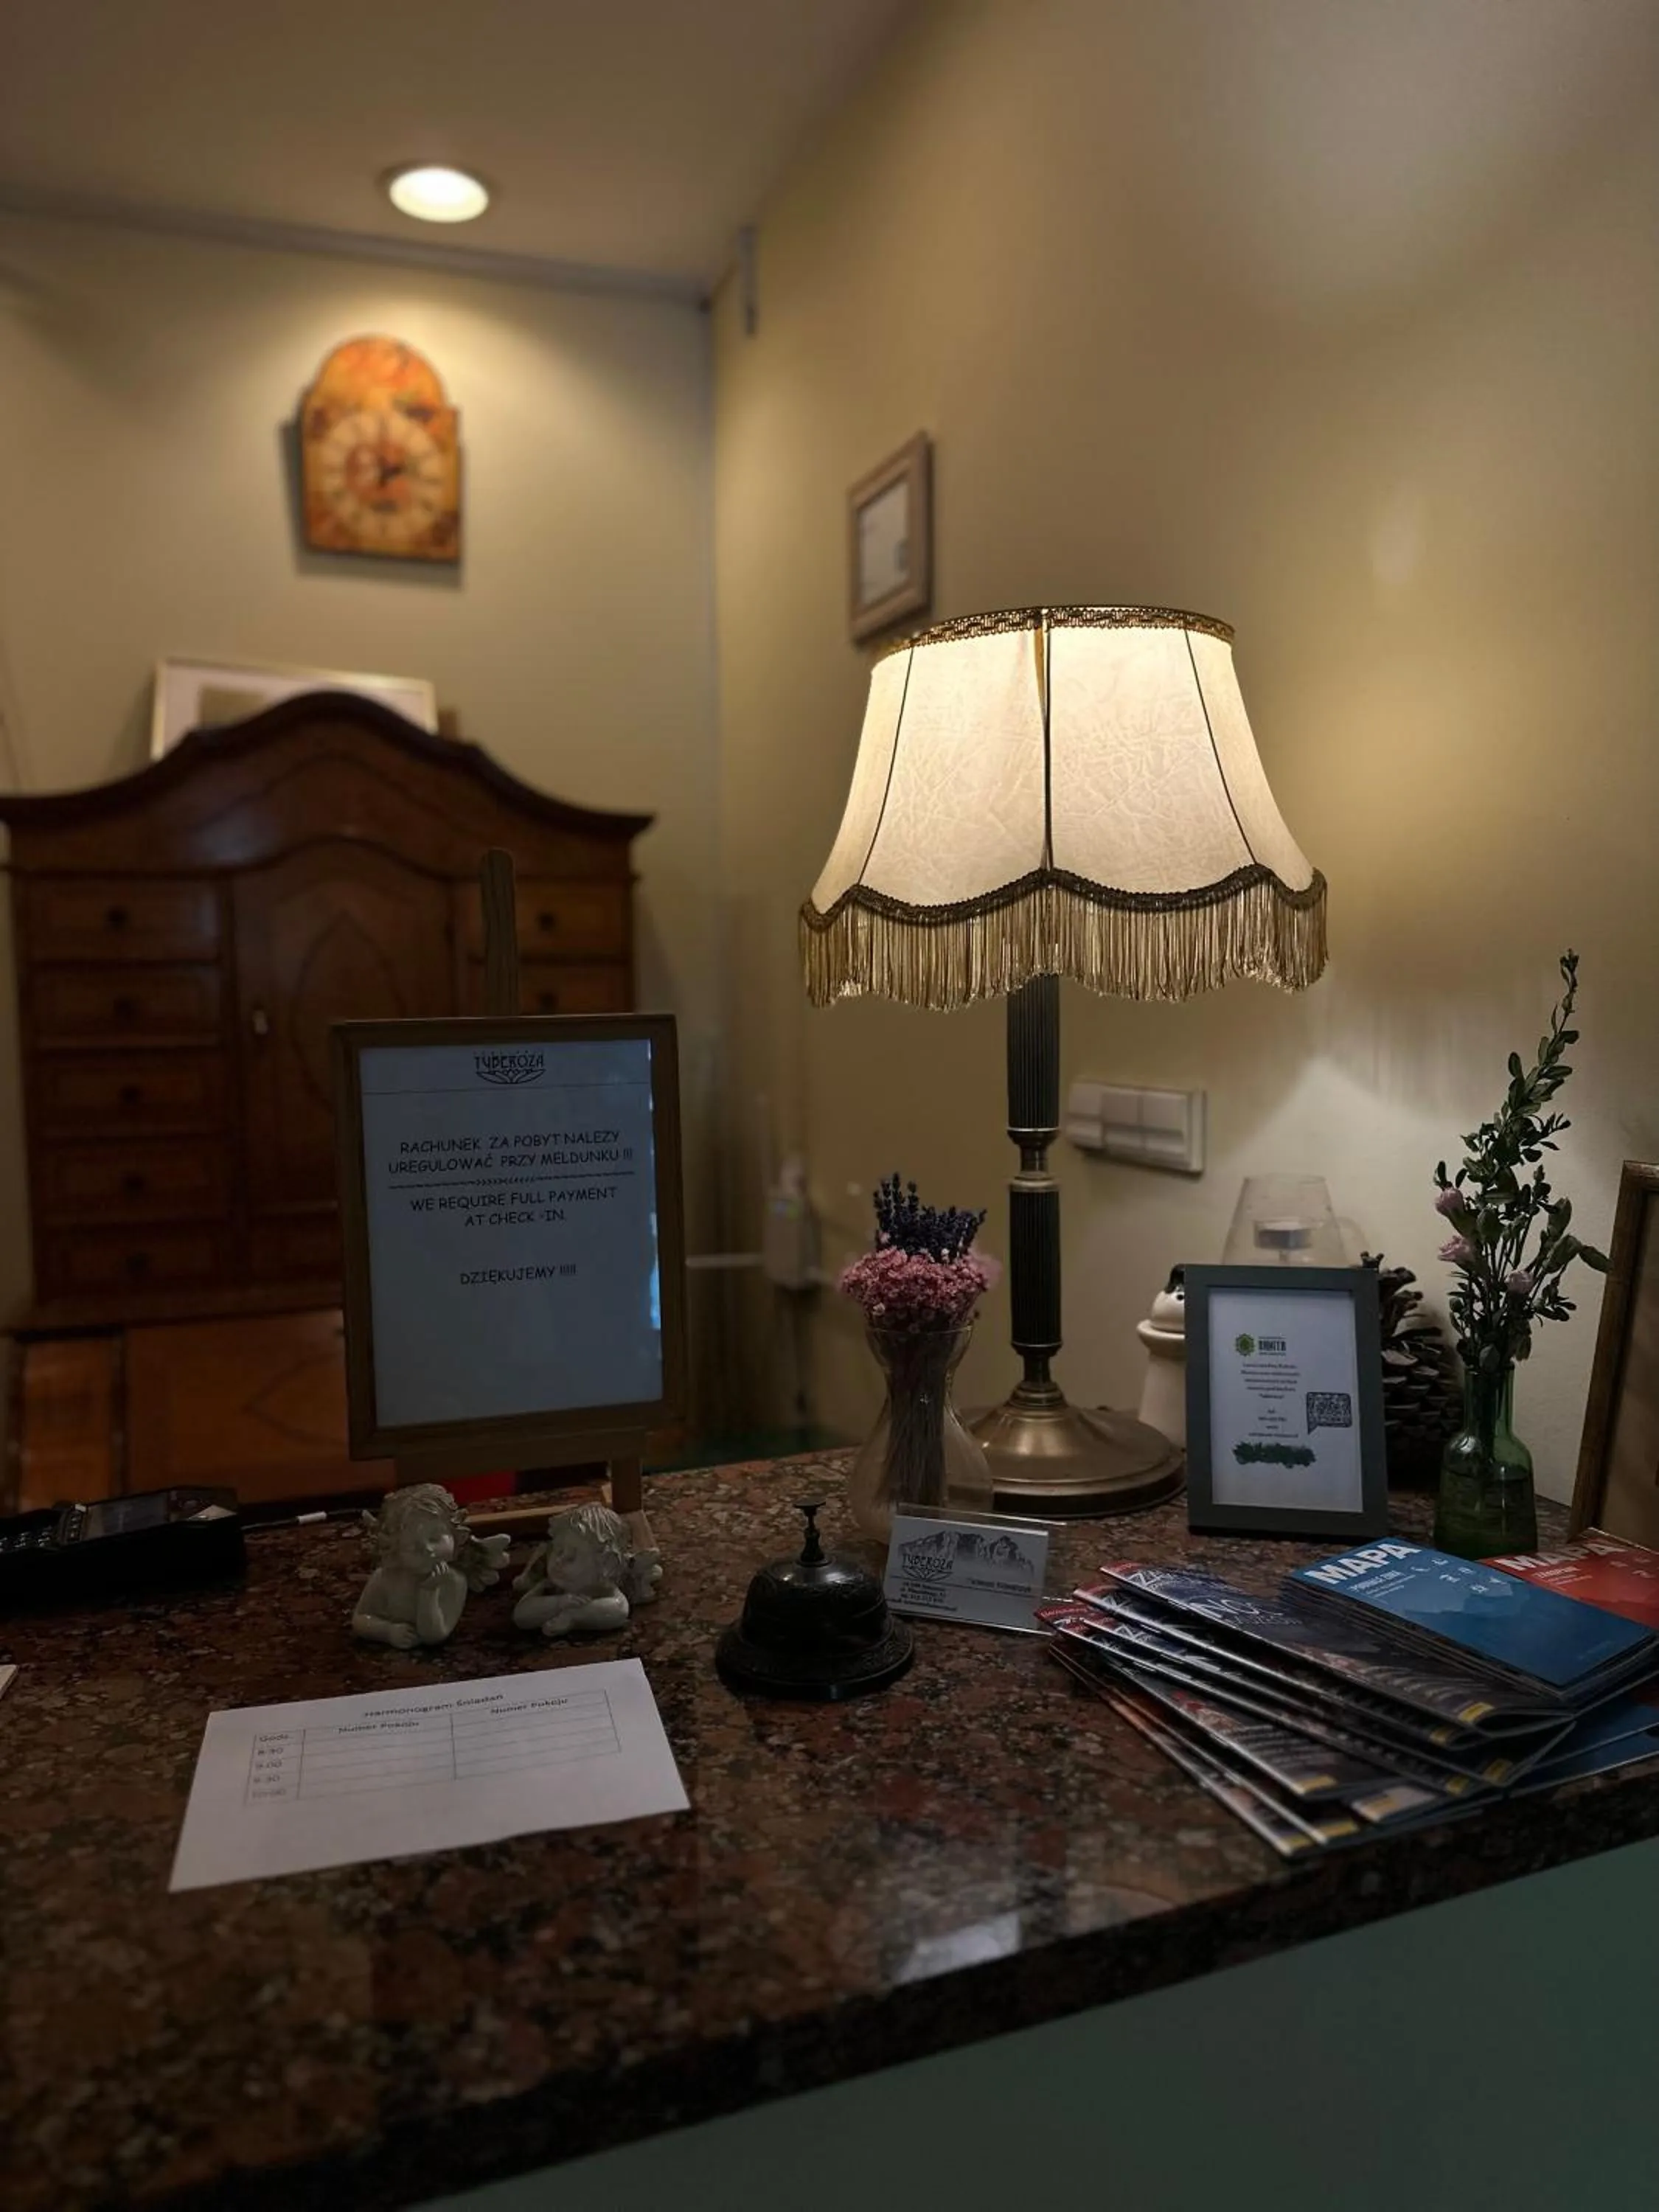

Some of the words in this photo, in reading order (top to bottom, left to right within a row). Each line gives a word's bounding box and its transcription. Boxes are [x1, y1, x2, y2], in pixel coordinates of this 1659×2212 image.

[400, 1138, 480, 1155] RACHUNEK
[489, 1135, 509, 1150] ZA
[513, 1133, 560, 1147] POBYT
[388, 1155, 493, 1174] UREGULOWAĆ
[500, 1153, 536, 1168] PRZY
[540, 1148, 619, 1166] MELDUNKU
[411, 1197, 434, 1211] WE
[438, 1191, 506, 1210] REQUIRE
[509, 1191, 544, 1205] FULL
[548, 1186, 618, 1203] PAYMENT
[464, 1213, 484, 1227] AT
[488, 1211, 534, 1225] CHECK
[1303, 1543, 1421, 1585] MAPA
[1493, 1541, 1630, 1571] MAPA
